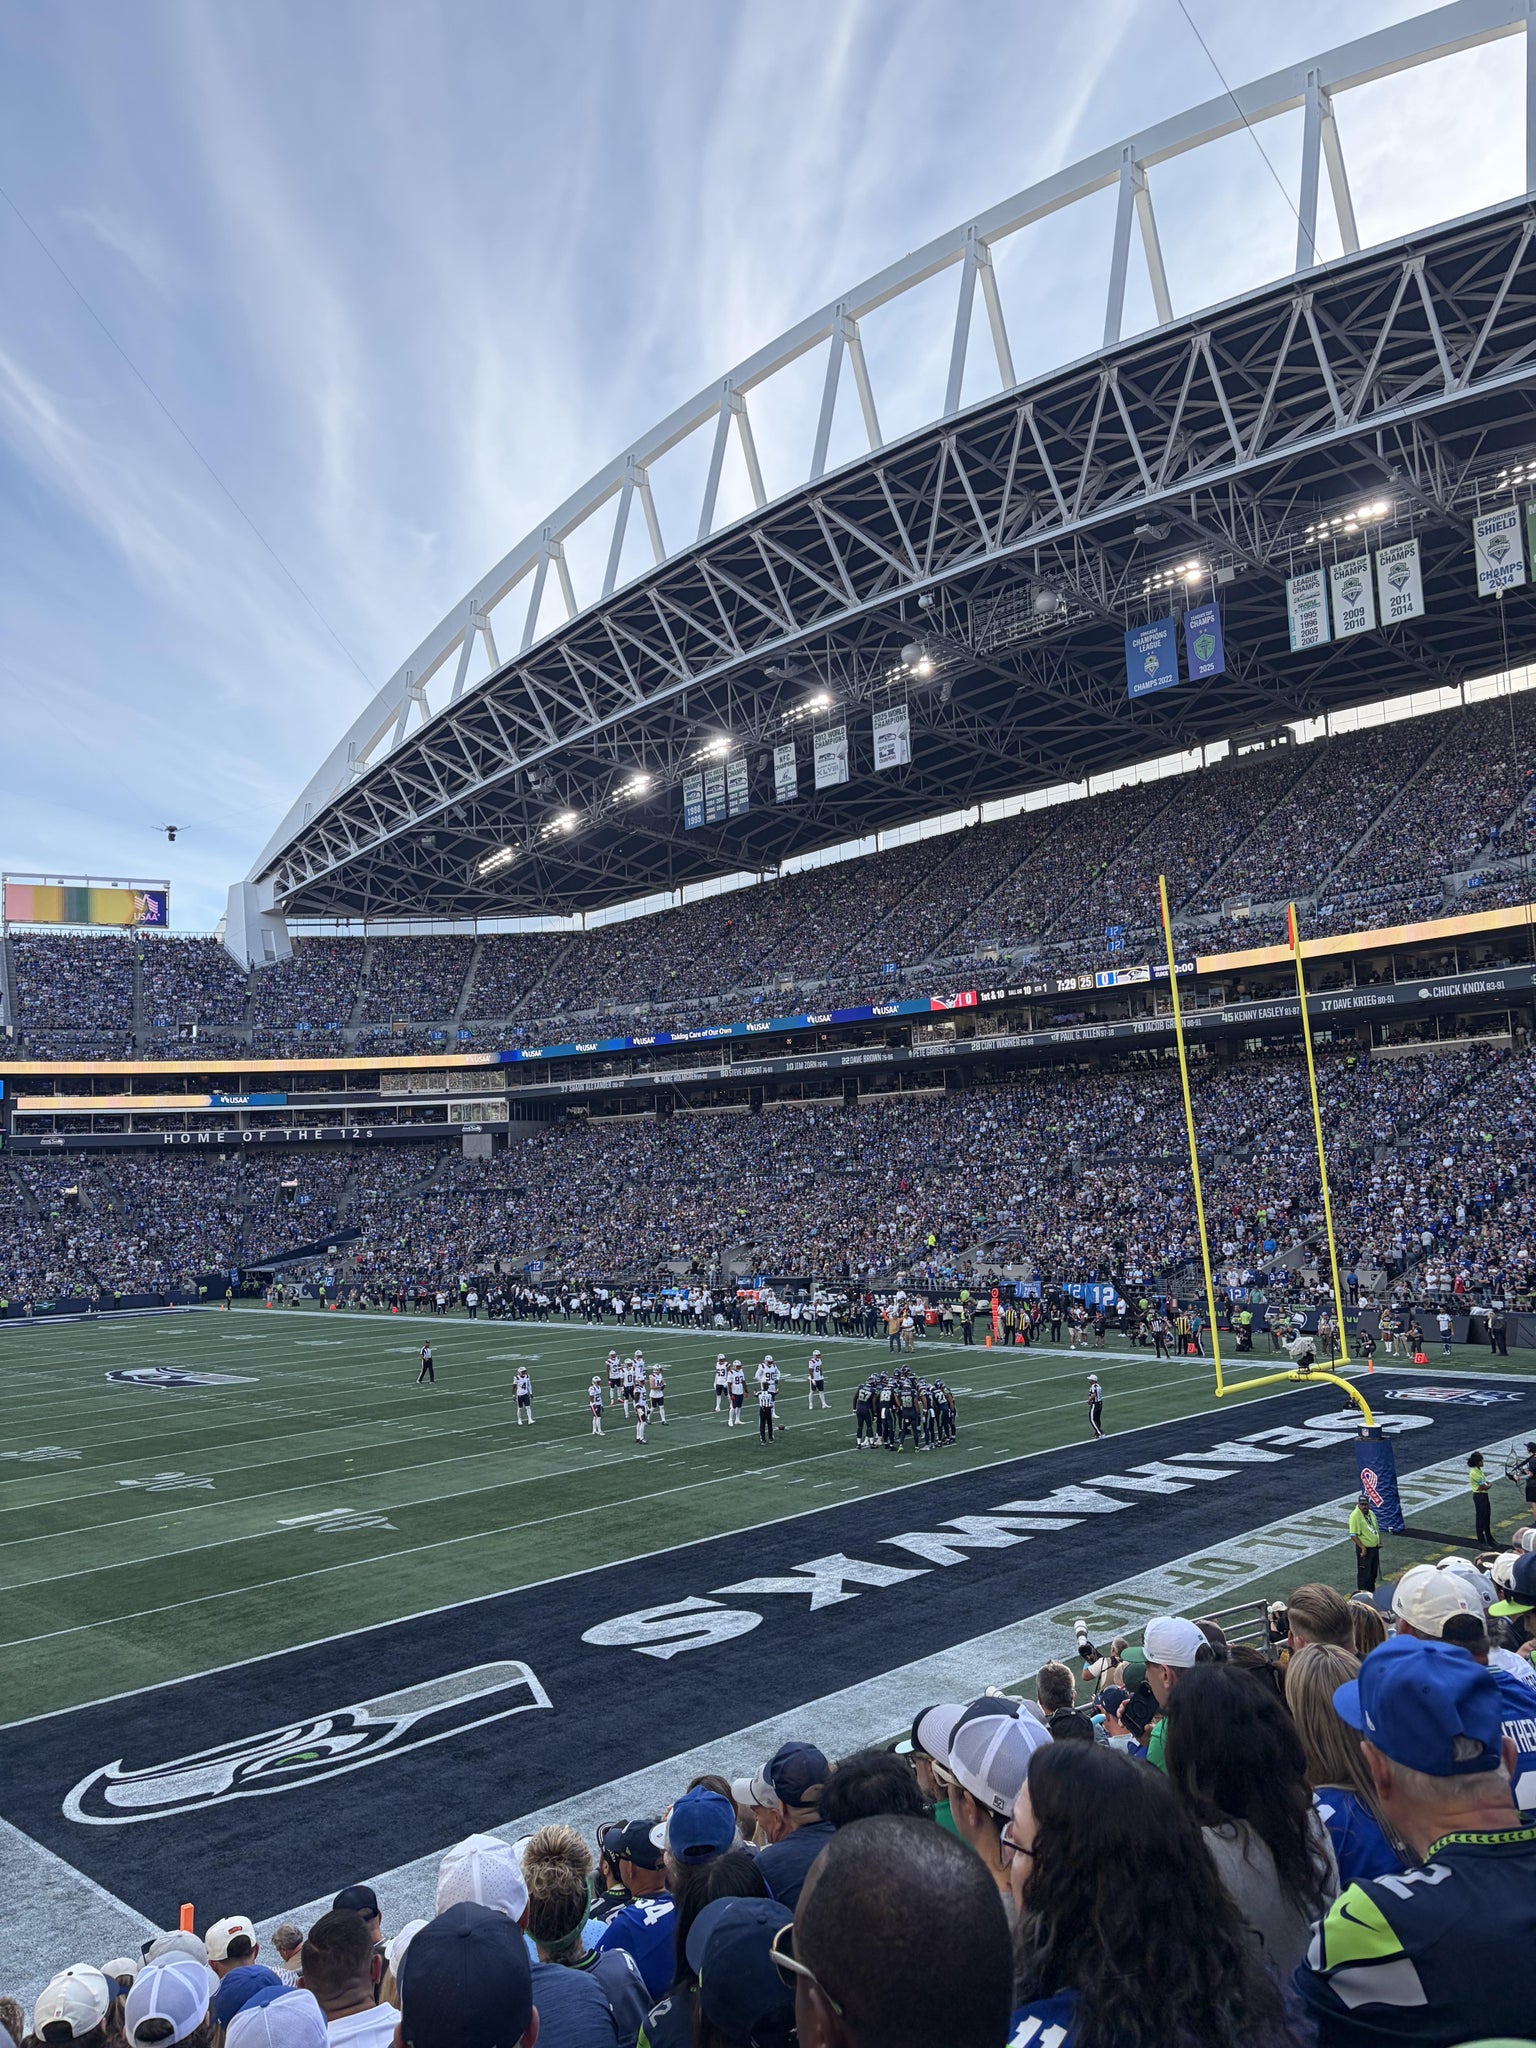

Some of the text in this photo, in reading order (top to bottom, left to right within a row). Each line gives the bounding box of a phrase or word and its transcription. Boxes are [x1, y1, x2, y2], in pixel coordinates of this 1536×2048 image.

[1477, 517, 1516, 537] SHIELD
[1390, 546, 1403, 555] OPEN
[1380, 548, 1415, 566] CHAMPS
[1334, 563, 1367, 580] CHAMPS
[1479, 561, 1523, 581] CHAMPS
[1293, 574, 1318, 587] LEAGUE
[1292, 581, 1320, 594] CHAMPS
[1390, 592, 1411, 607] 2011
[1300, 610, 1317, 621] 1995
[1343, 606, 1365, 620] 2009
[1391, 603, 1413, 617] 2014
[1190, 615, 1215, 629] CHAMPS
[1300, 619, 1317, 629] 1996
[1344, 617, 1365, 631] 2010
[1301, 627, 1318, 637] 2005
[1132, 630, 1167, 647] CHAMPIONS
[1302, 635, 1319, 646] 2007
[1139, 640, 1161, 653] LEAGUE
[1199, 662, 1215, 673] 2025
[1133, 674, 1173, 692] CHAMPS 2022
[874, 714, 907, 730] CHAMPIONS
[827, 727, 845, 738] WORLD
[815, 735, 845, 750] CHAMPIONS
[779, 754, 790, 763] NFC
[728, 767, 747, 778] CHAMPS
[705, 773, 724, 785] CHAMPS
[134, 913, 158, 921] USAA
[1110, 927, 1118, 936] 12
[1111, 941, 1121, 951] 12
[886, 964, 894, 973] 12
[1056, 978, 1076, 991] 7:29
[1080, 976, 1092, 988] 25
[1101, 973, 1109, 986] 0
[980, 989, 1005, 1001] 1st & 10
[1023, 985, 1031, 995] 10
[1433, 980, 1505, 998] CHUCK KNOX 83-91
[965, 993, 972, 1004] 0
[1321, 995, 1395, 1011] 17 DAVE KRIEG 80-91
[881, 1005, 898, 1015] USAA
[1221, 1006, 1300, 1023] 45 KENNY EASLEY 81-87
[814, 1014, 830, 1023] USAA
[754, 1022, 769, 1031] USAA
[1133, 1023, 1144, 1033] 79
[1144, 1021, 1164, 1032] JACOB
[1165, 1018, 1187, 1030] GRN
[640, 1036, 654, 1045] USAA
[670, 1033, 688, 1041] Taking
[1060, 1031, 1075, 1042] PAUL
[1076, 1030, 1082, 1040] G.
[1082, 1028, 1100, 1039] ALLEN
[971, 1042, 980, 1051] 28
[981, 1040, 995, 1050] CURT
[996, 1038, 1020, 1049] WARNER
[913, 1047, 925, 1057] PETE
[926, 1046, 944, 1056] GROSS
[841, 1053, 881, 1065] 22 DAVE BROWN
[729, 1067, 742, 1077] STEVE
[742, 1066, 762, 1076] LARGENT
[786, 1061, 817, 1071] 10 JIM ZORN
[586, 1081, 612, 1091] ALEXANDER
[164, 1128, 373, 1144] HOME OF THE 12s
[1093, 1286, 1114, 1306] 12
[1229, 1288, 1242, 1301] 12
[627, 1374, 633, 1383] 0
[735, 1376, 743, 1385] 93
[765, 1372, 775, 1381] 90
[521, 1382, 527, 1391] 4
[858, 1389, 872, 1402] 67
[581, 1410, 1436, 1660] SEAHAWKS
[1051, 1514, 1352, 1633] ALL OF US
